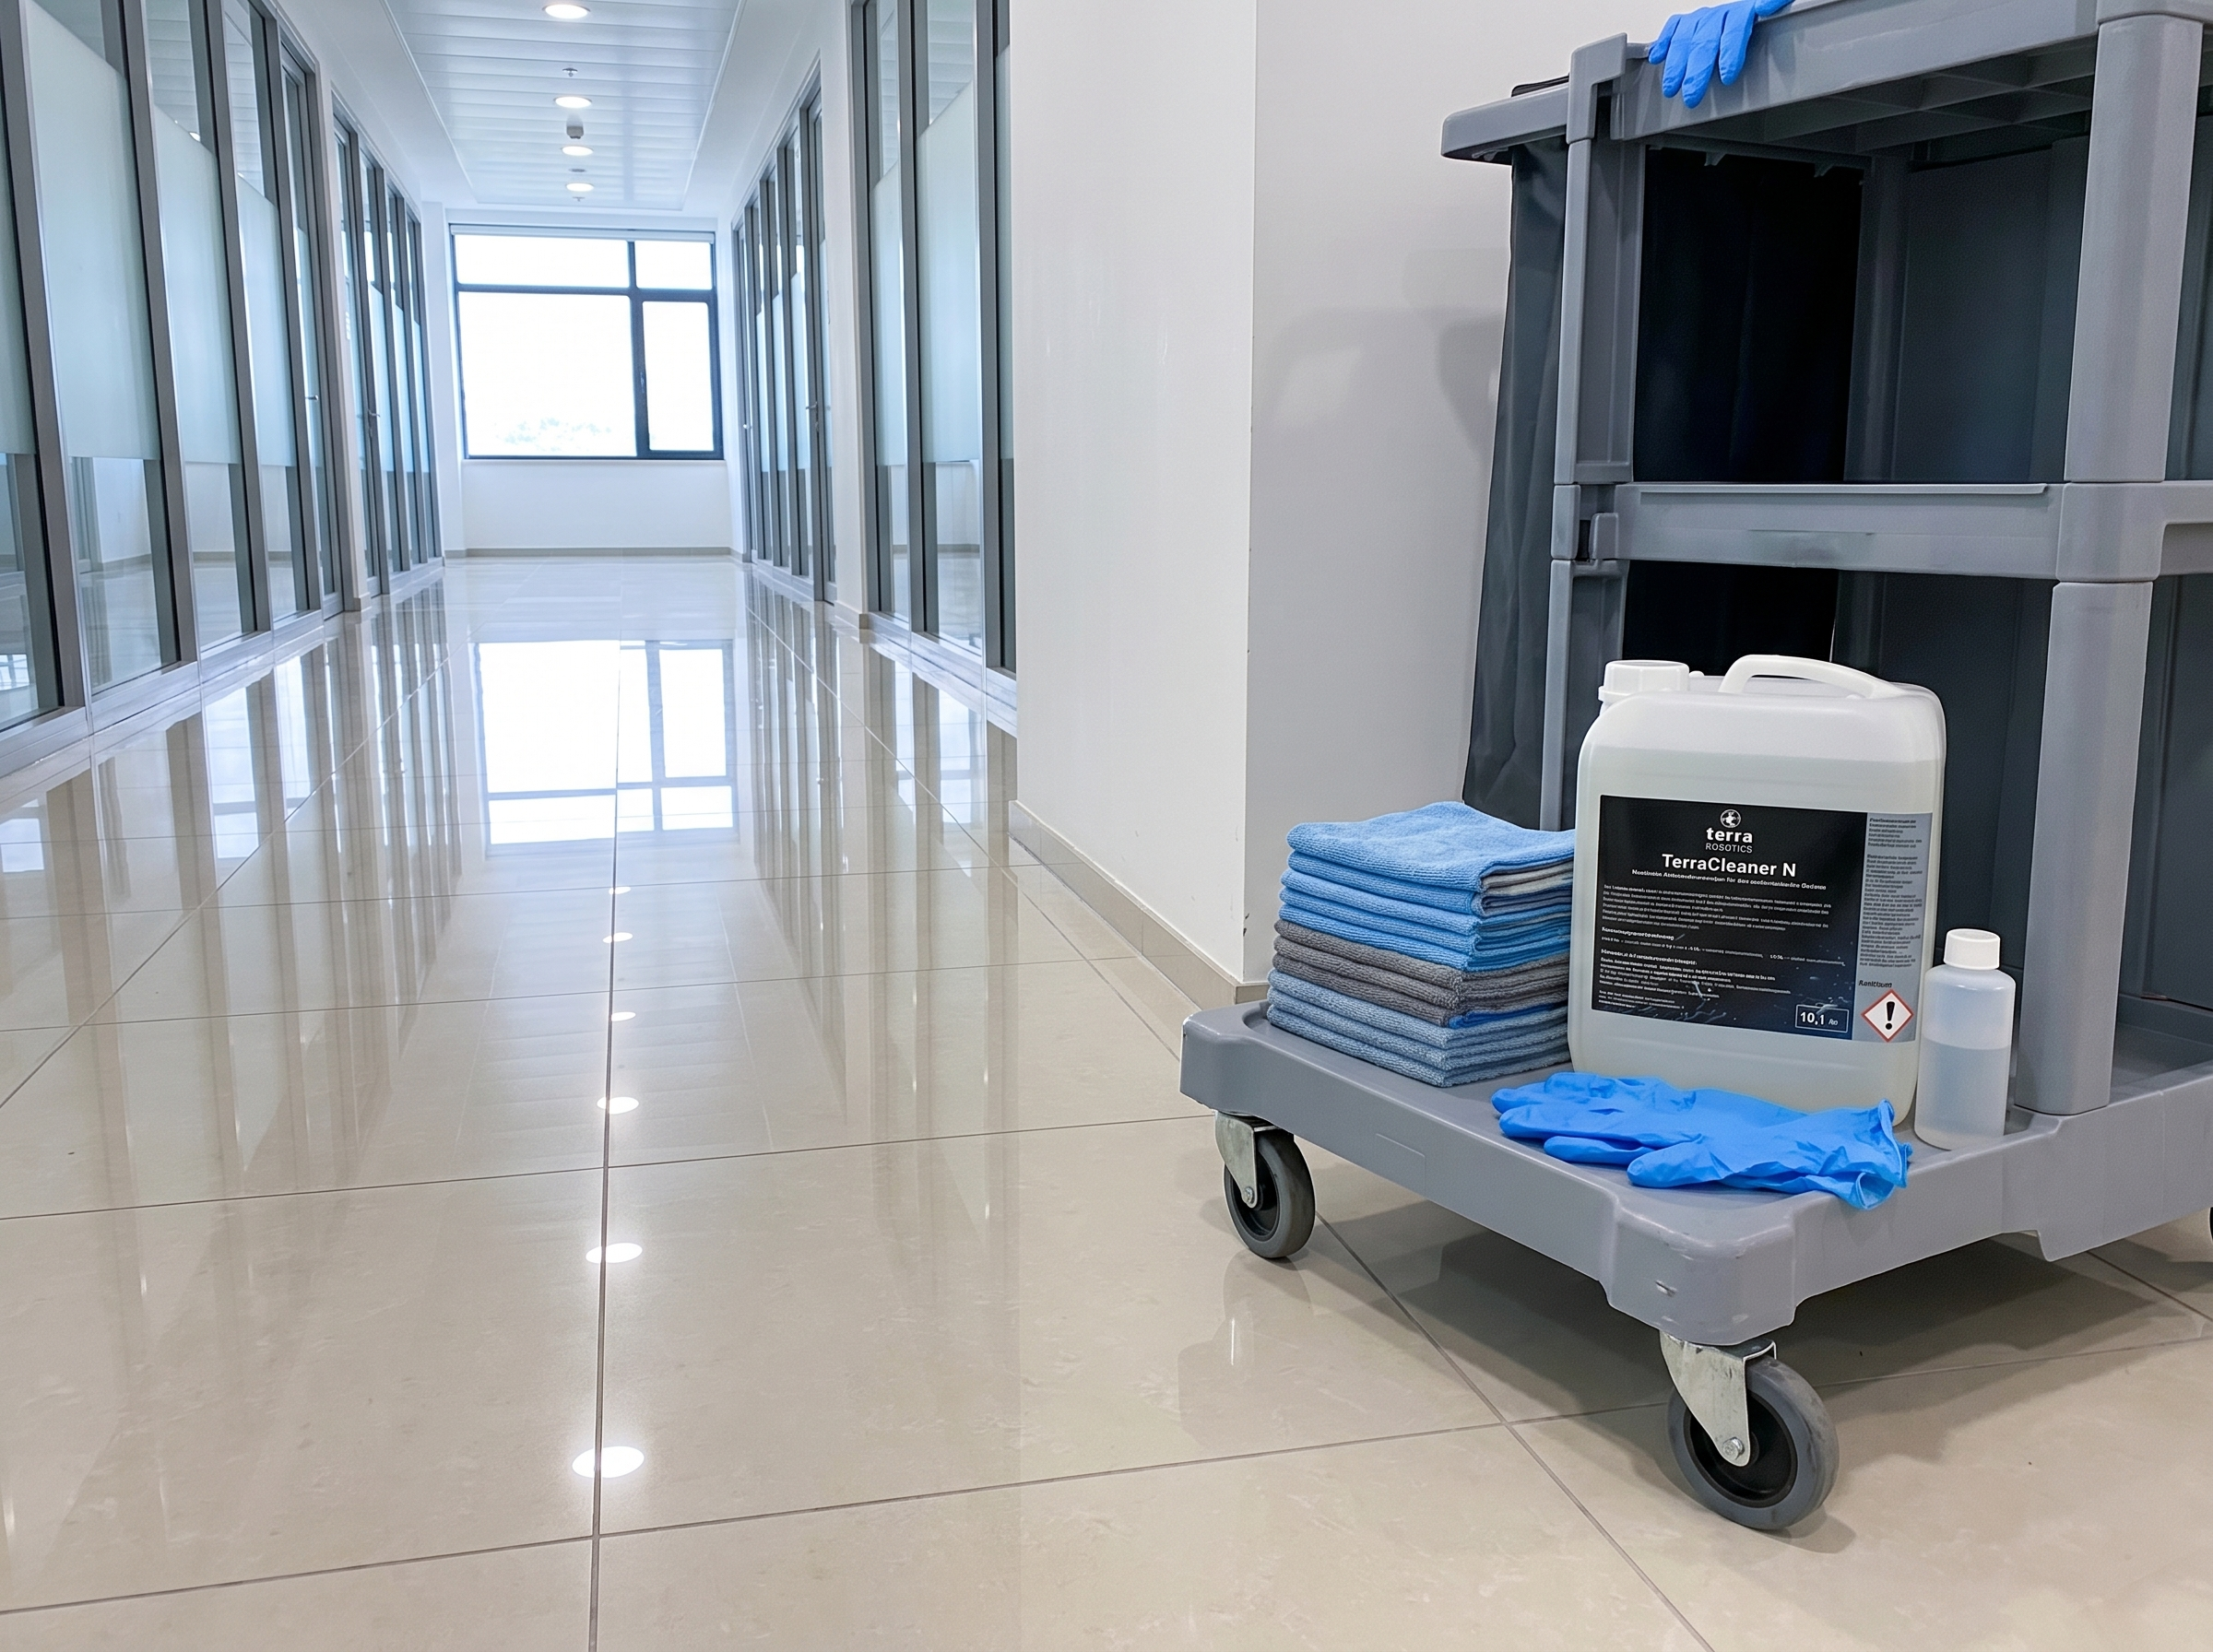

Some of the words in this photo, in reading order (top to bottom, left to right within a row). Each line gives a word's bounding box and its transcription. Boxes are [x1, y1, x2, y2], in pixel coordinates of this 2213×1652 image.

[1706, 827, 1753, 844] terra
[1662, 853, 1777, 876] TerraCleaner
[1782, 862, 1796, 878] N
